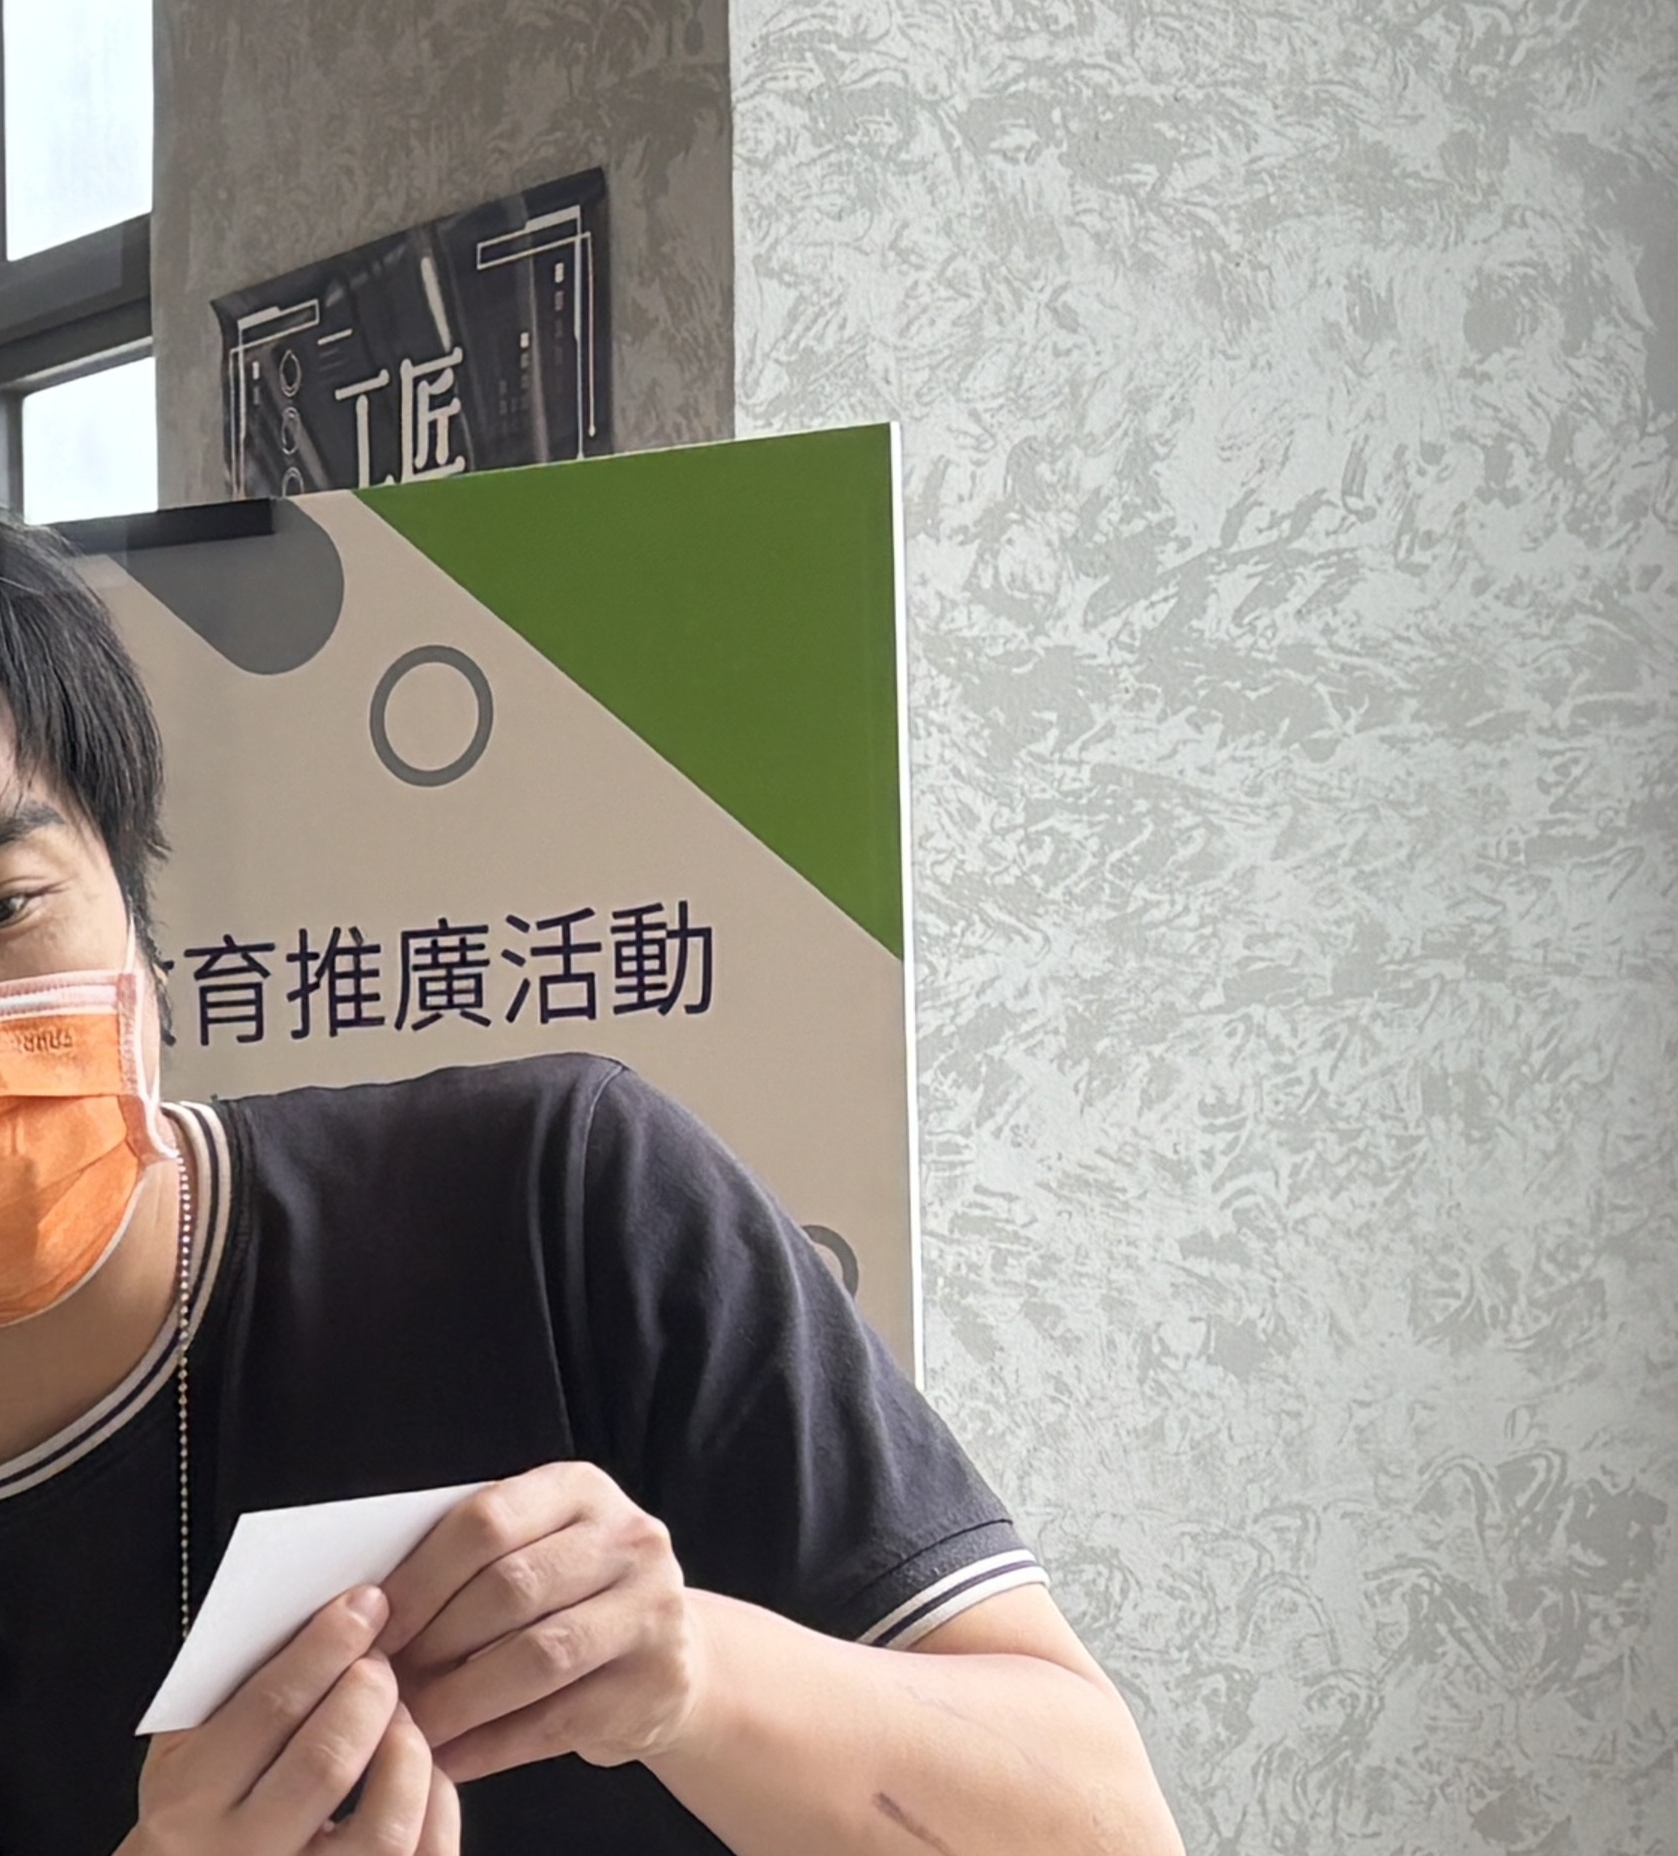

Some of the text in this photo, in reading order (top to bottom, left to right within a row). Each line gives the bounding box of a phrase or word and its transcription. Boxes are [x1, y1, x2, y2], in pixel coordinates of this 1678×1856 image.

[162, 899, 713, 1047] 育推廣活動
